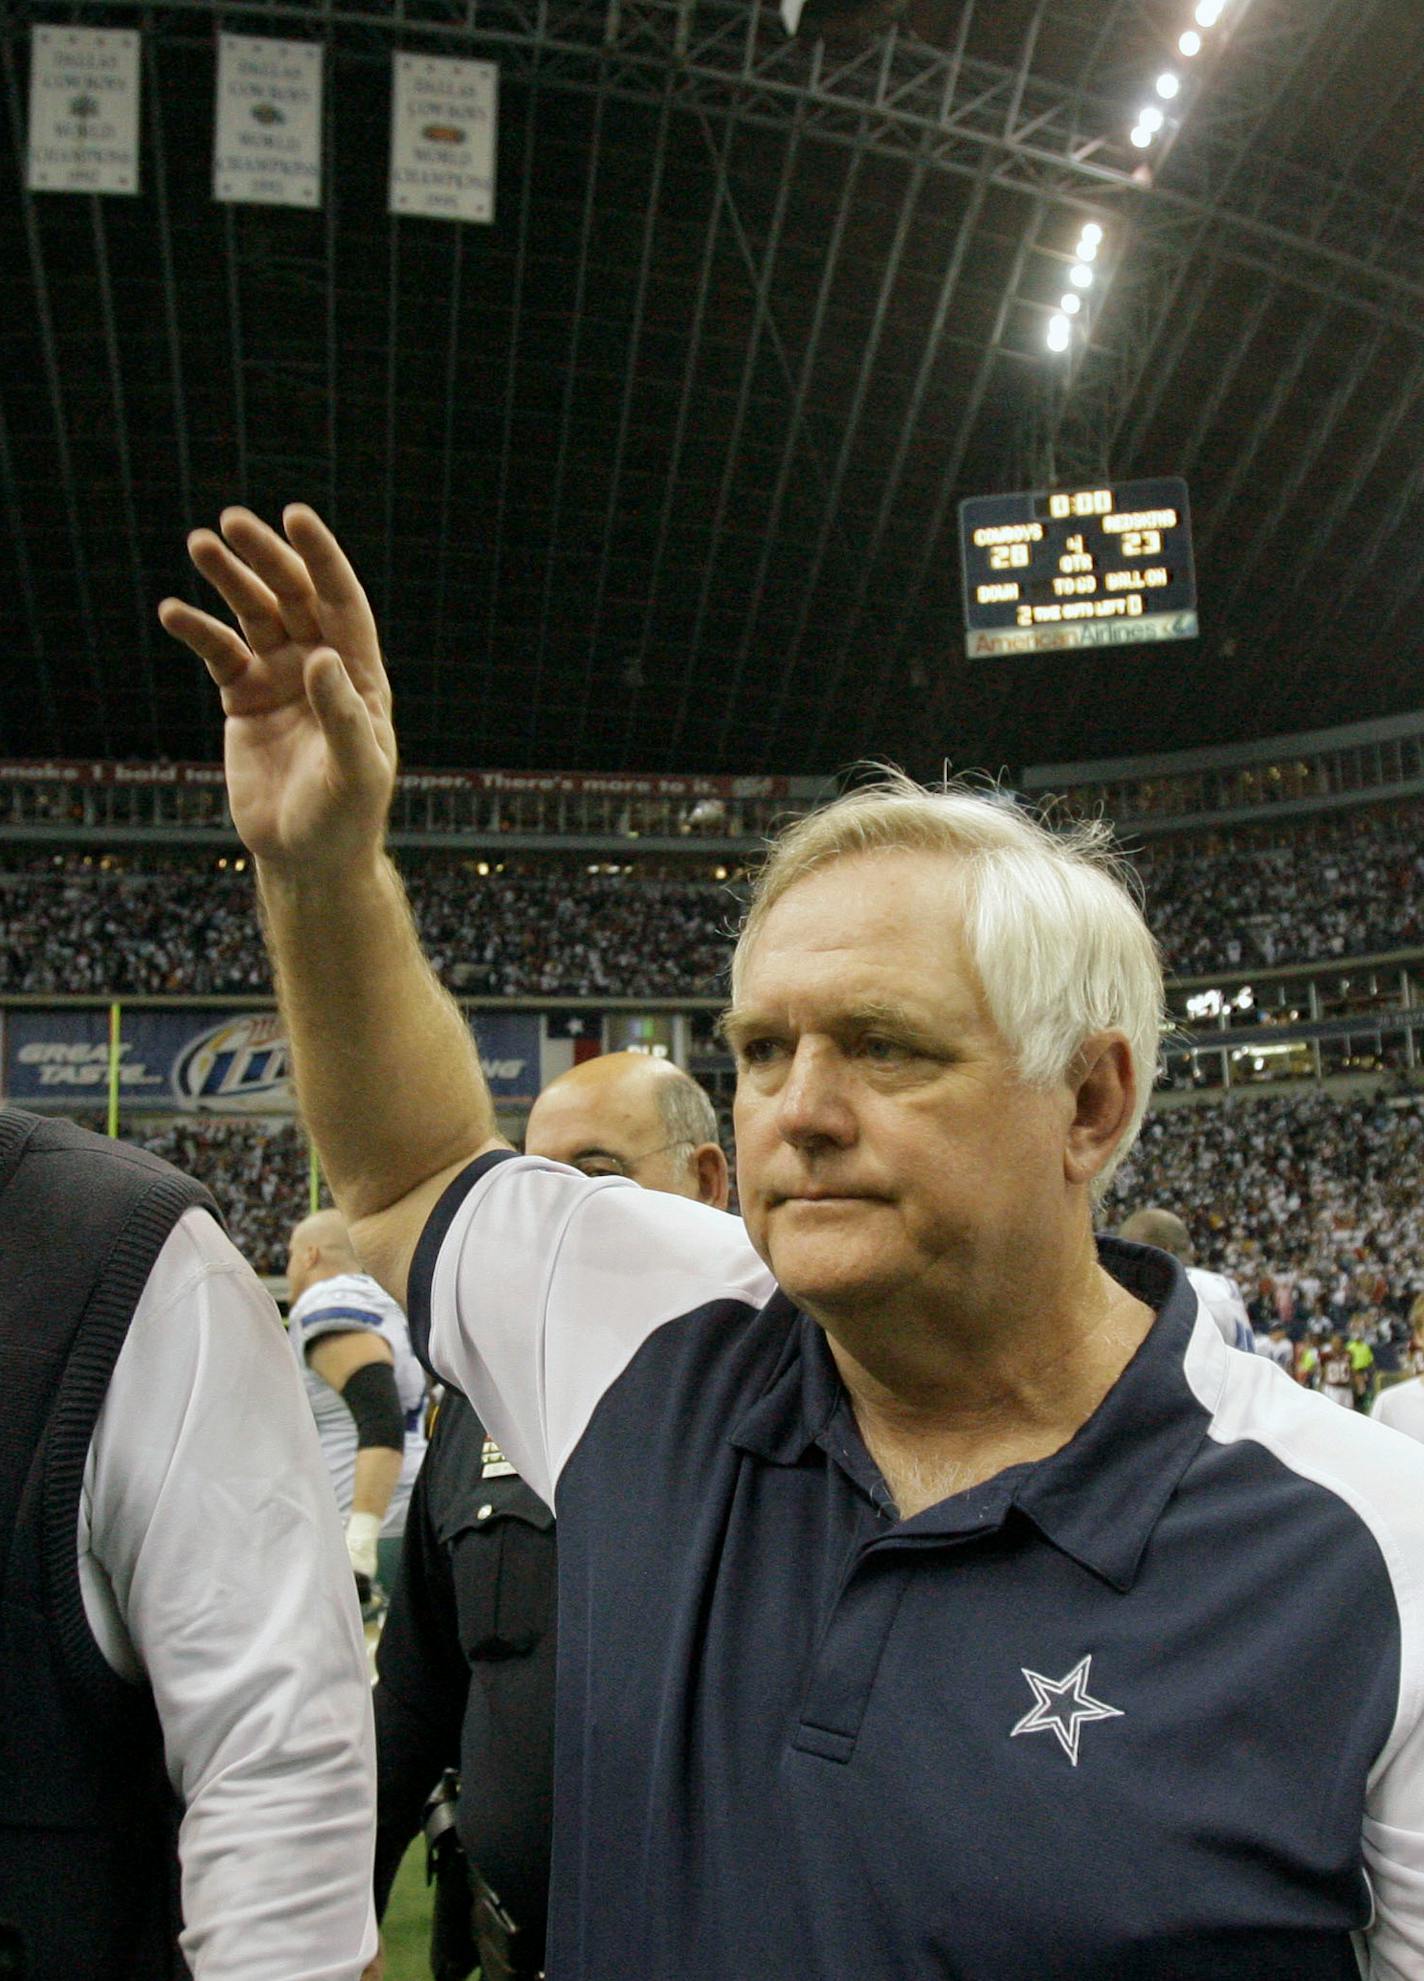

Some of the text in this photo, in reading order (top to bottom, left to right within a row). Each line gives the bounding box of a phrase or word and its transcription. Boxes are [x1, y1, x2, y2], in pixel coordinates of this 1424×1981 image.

[1121, 530, 1162, 557] 23
[1052, 575, 1097, 596] TO GO
[1105, 567, 1168, 591] BALL ON
[482, 772, 573, 790] There's
[583, 778, 650, 793] more
[659, 778, 686, 793] to
